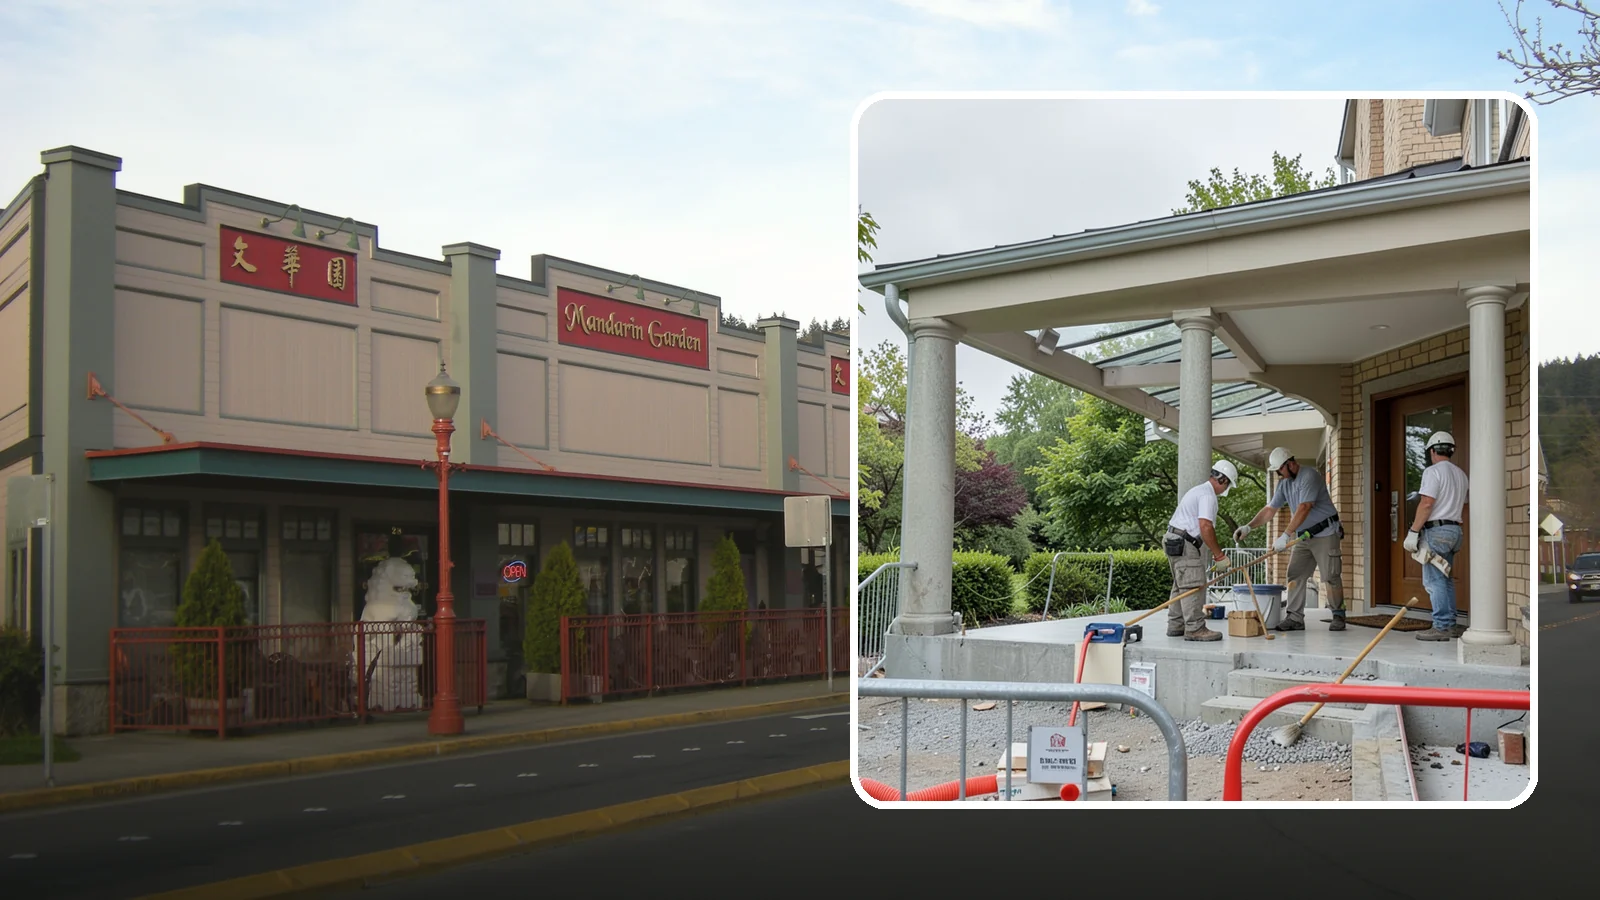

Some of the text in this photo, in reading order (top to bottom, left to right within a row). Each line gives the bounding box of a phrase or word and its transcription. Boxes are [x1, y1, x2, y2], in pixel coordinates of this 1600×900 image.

[564, 302, 701, 352] Mandarin Garden
[503, 565, 527, 578] OPEN
